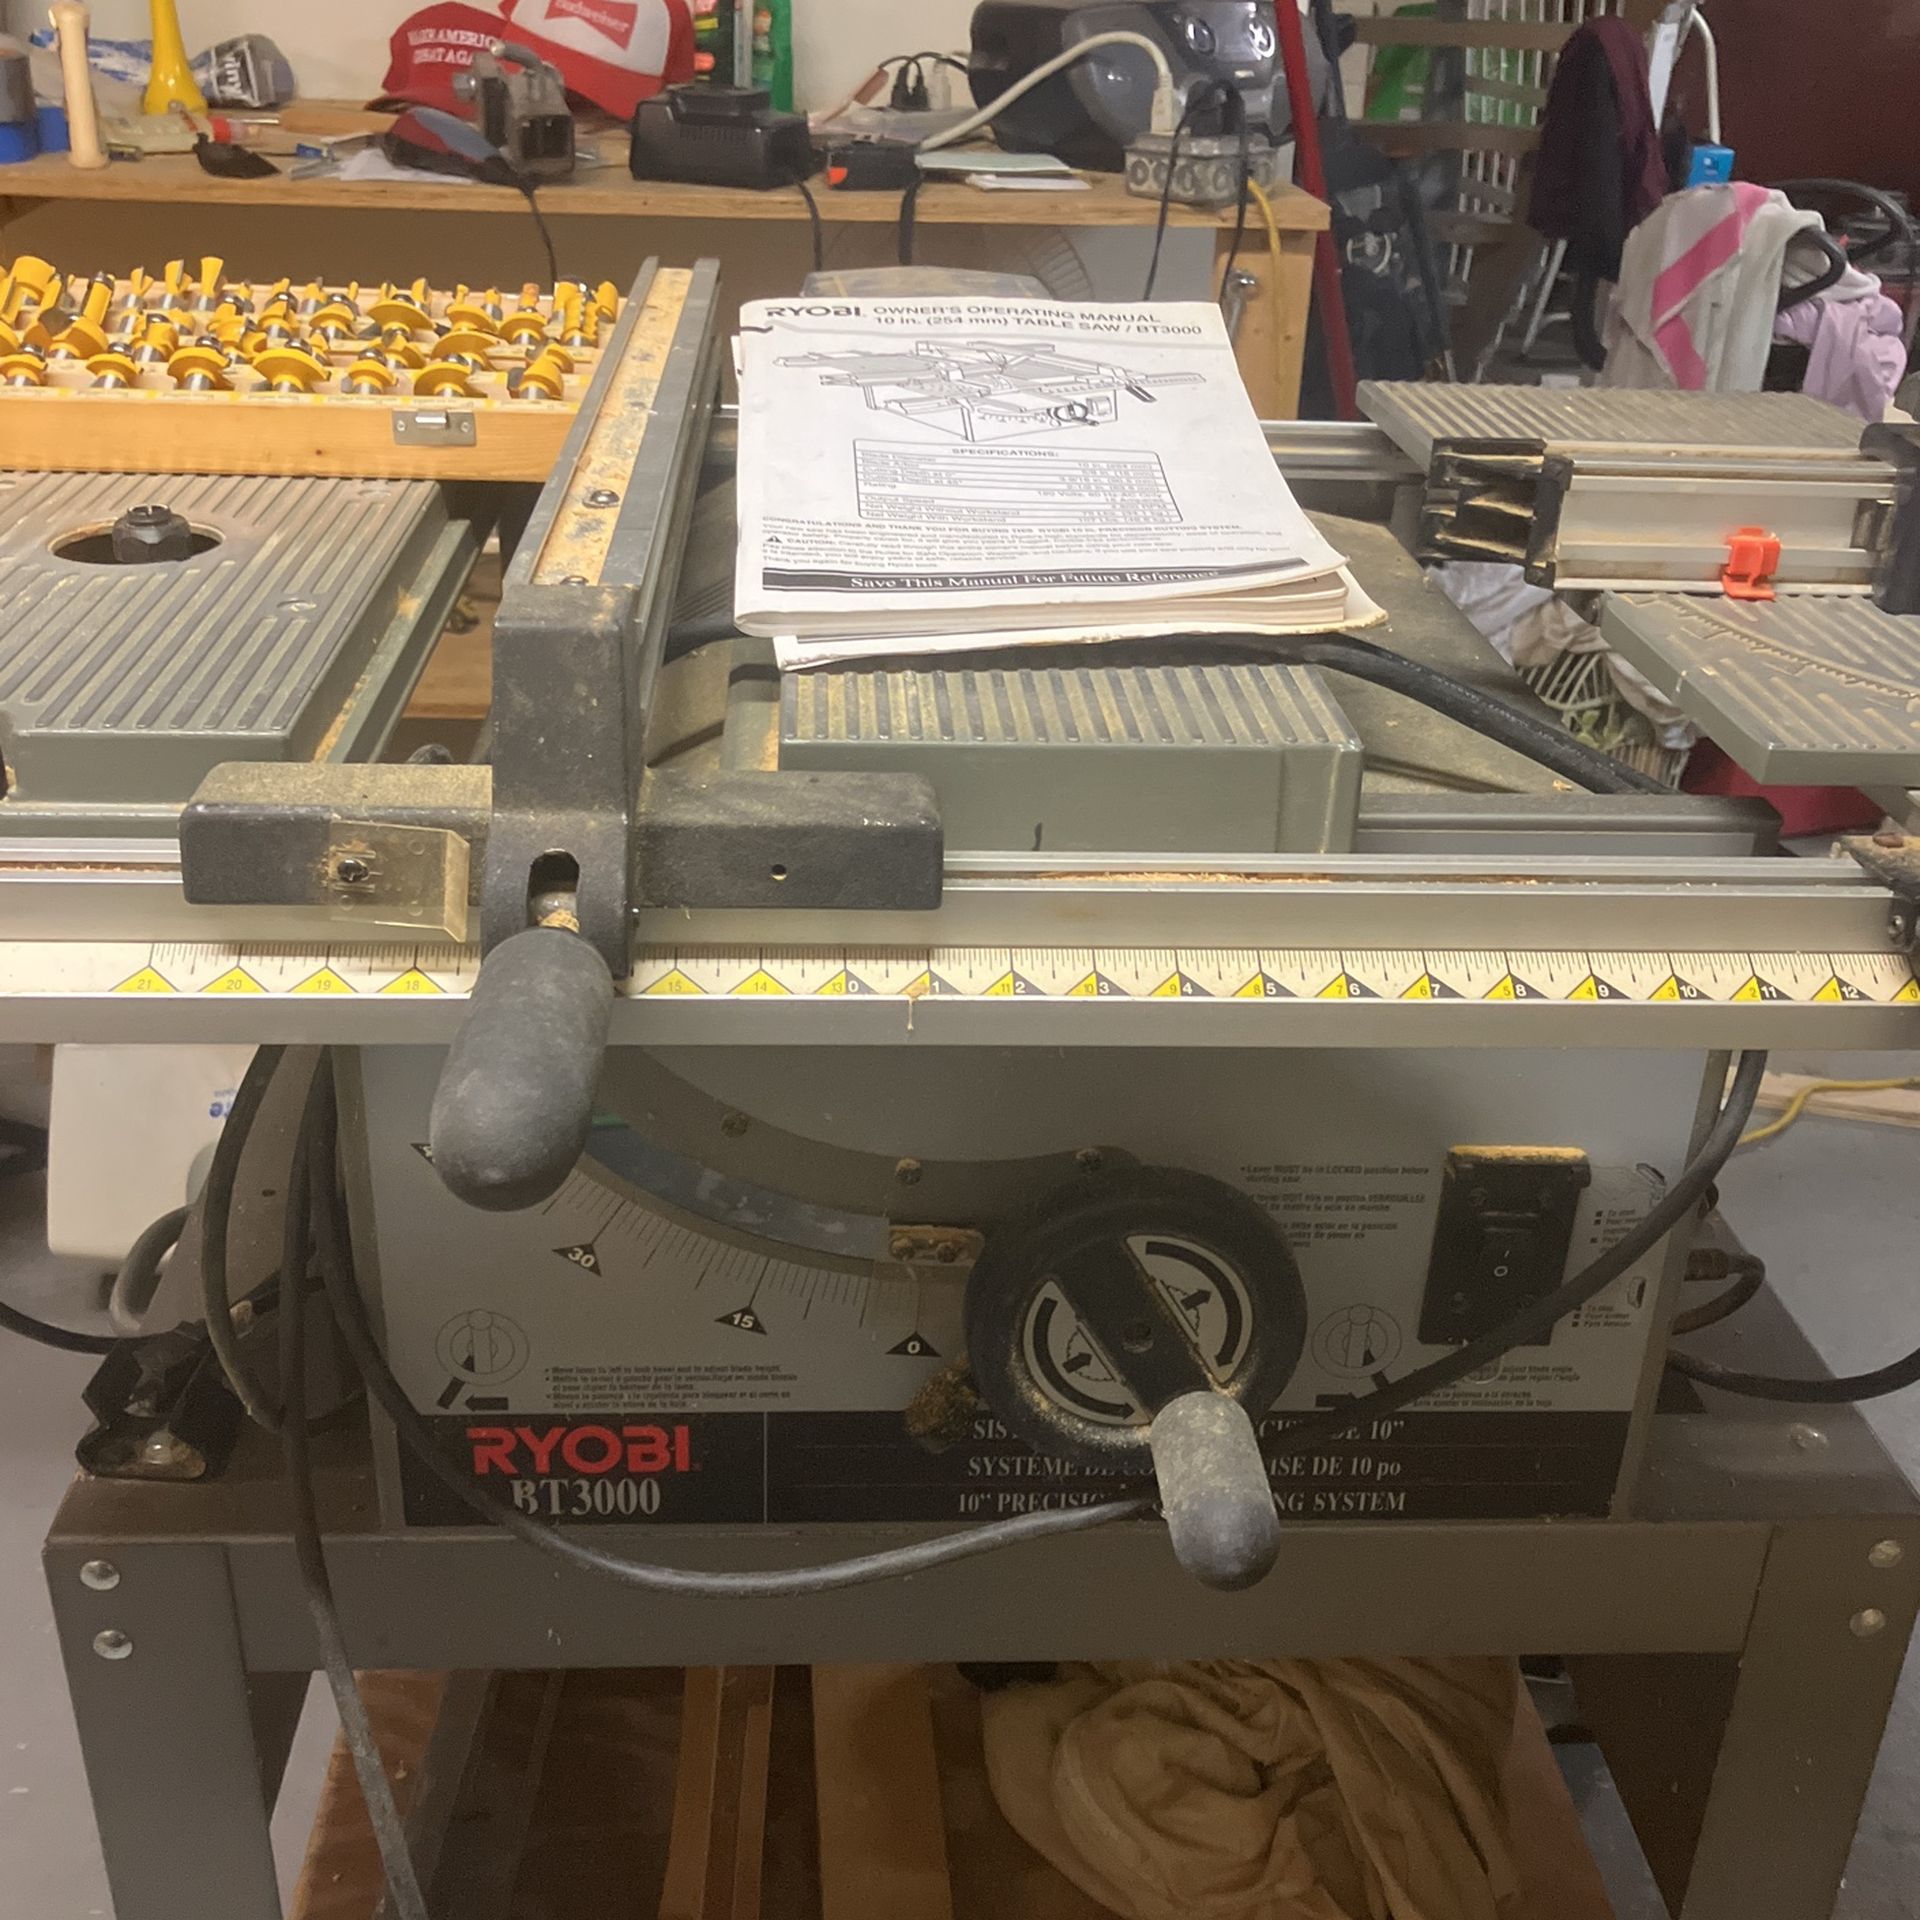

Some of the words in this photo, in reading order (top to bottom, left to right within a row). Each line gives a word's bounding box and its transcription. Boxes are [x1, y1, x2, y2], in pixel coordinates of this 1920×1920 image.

[437, 28, 496, 48] AMERIC
[765, 306, 861, 317] RYOBI
[873, 306, 962, 315] OWNER'S
[967, 306, 1075, 319] OPERATING
[1080, 312, 1161, 323] MANUAL
[875, 317, 894, 325] 10
[927, 317, 962, 326] (254
[969, 317, 1008, 326] mm)
[1015, 317, 1073, 328] TABLE
[1079, 323, 1119, 332] SAW
[1136, 325, 1202, 335] BT3000
[851, 577, 896, 588] Save
[900, 577, 944, 588] This
[948, 575, 1018, 587] Manual
[1024, 574, 1057, 585] For
[1062, 573, 1120, 583] Future
[137, 979, 152, 990] 21
[226, 979, 243, 991] 20
[316, 979, 331, 991] 19
[406, 980, 420, 991] 18
[668, 981, 682, 993] 15
[754, 981, 767, 993] 14
[832, 981, 842, 993] 13
[1001, 983, 1011, 994] 11
[1084, 983, 1094, 995] 10
[848, 981, 859, 993] 0
[933, 981, 940, 993] 1
[1015, 982, 1026, 994] 2
[1099, 982, 1110, 994] 3
[1182, 982, 1193, 994] 4
[1266, 982, 1277, 995] 5
[1349, 983, 1360, 996] 6
[1431, 983, 1441, 996] 7
[1515, 984, 1527, 997] 8
[1598, 985, 1609, 998] 9
[1679, 986, 1697, 998] 10
[1761, 986, 1778, 999] 11
[1842, 986, 1859, 999] 12
[568, 1247, 595, 1267] 30
[733, 1312, 754, 1329] 15
[907, 1340, 921, 1354] 0
[972, 1419, 1018, 1440] SIS
[466, 1425, 690, 1475] RYOBI
[1271, 1456, 1306, 1476] ISE
[1312, 1456, 1343, 1476] DE
[1351, 1456, 1372, 1476] 10
[1376, 1461, 1401, 1481] po
[511, 1479, 661, 1516] BT3000
[1274, 1492, 1305, 1511] NG
[1313, 1492, 1406, 1512] SYSTEM
